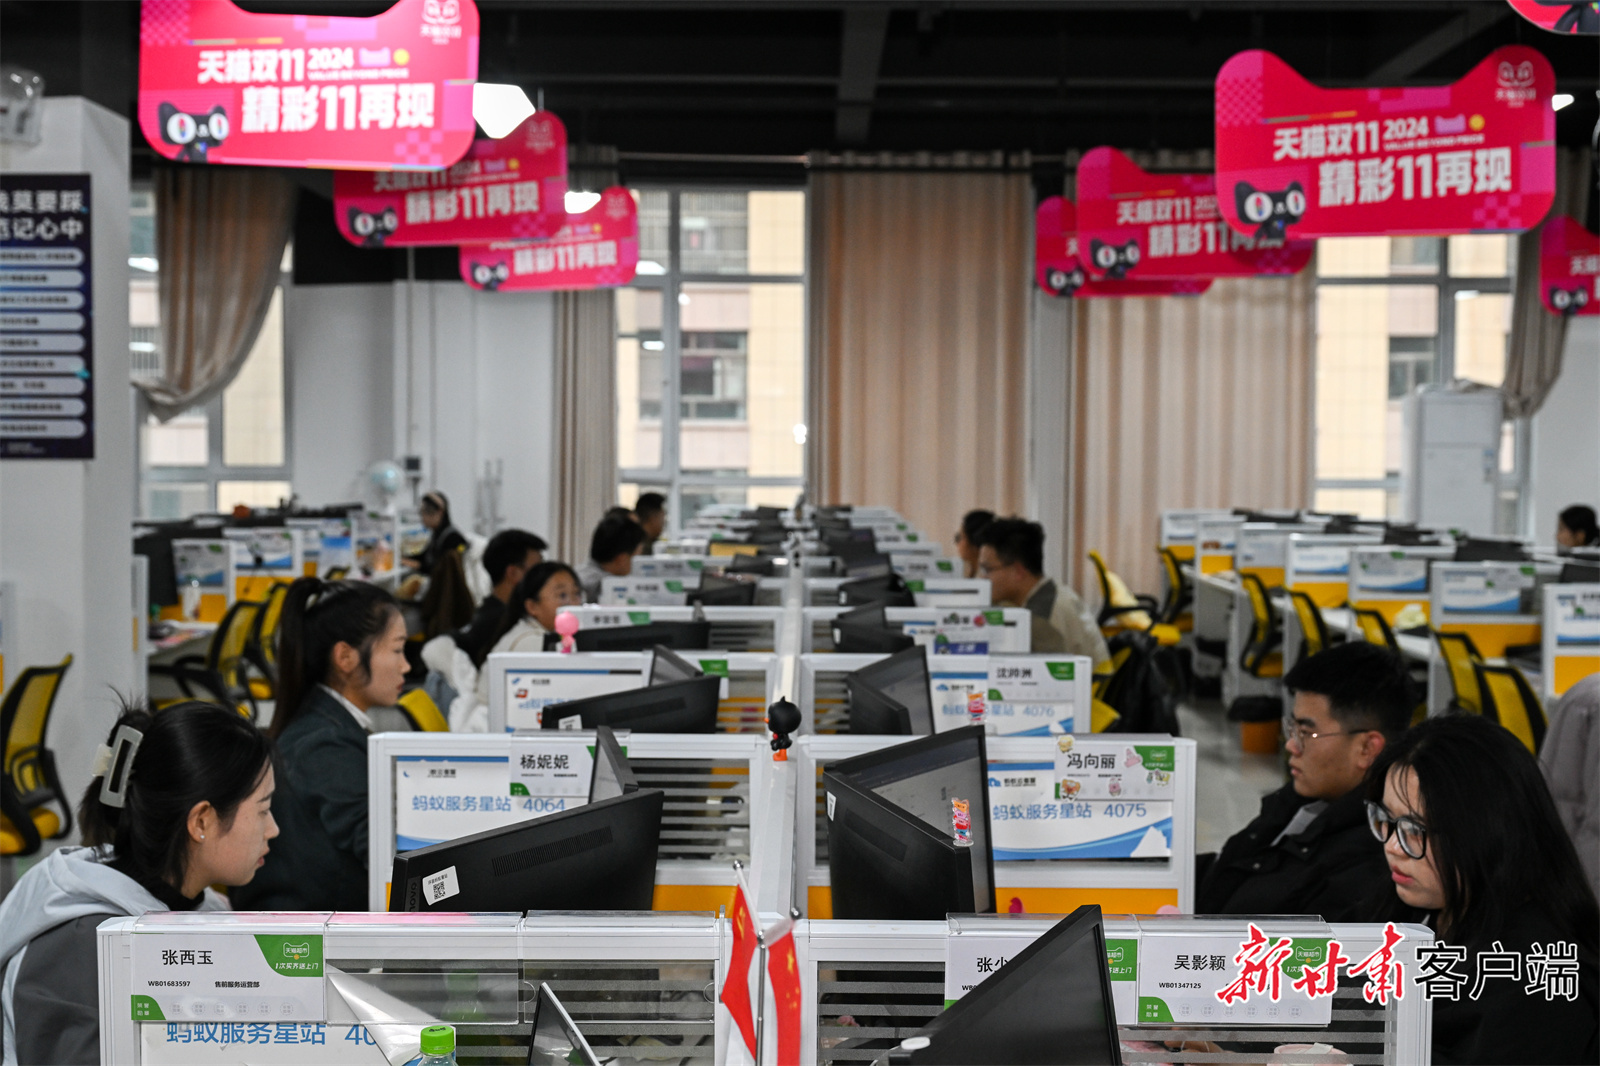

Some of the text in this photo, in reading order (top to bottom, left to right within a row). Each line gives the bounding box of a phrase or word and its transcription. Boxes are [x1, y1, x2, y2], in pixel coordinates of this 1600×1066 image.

[197, 47, 354, 83] 天猫双11 2024
[241, 83, 435, 133] 精彩11再现
[1273, 116, 1429, 161] 天猫双11 2024
[1318, 147, 1512, 208] 精彩11再现
[405, 181, 539, 225] 精彩11再现
[520, 754, 570, 770] 杨妮妮
[1067, 753, 1117, 769] 冯向丽
[412, 795, 512, 812] 蚂蚁服务星站
[992, 802, 1148, 821] 蚂蚁服务星站 4075
[162, 949, 214, 966] 张西玉
[275, 962, 319, 970] 1次买齐送上门
[1174, 954, 1226, 971] 吴影颖
[166, 1022, 326, 1045] 蚂蚁服务星站
